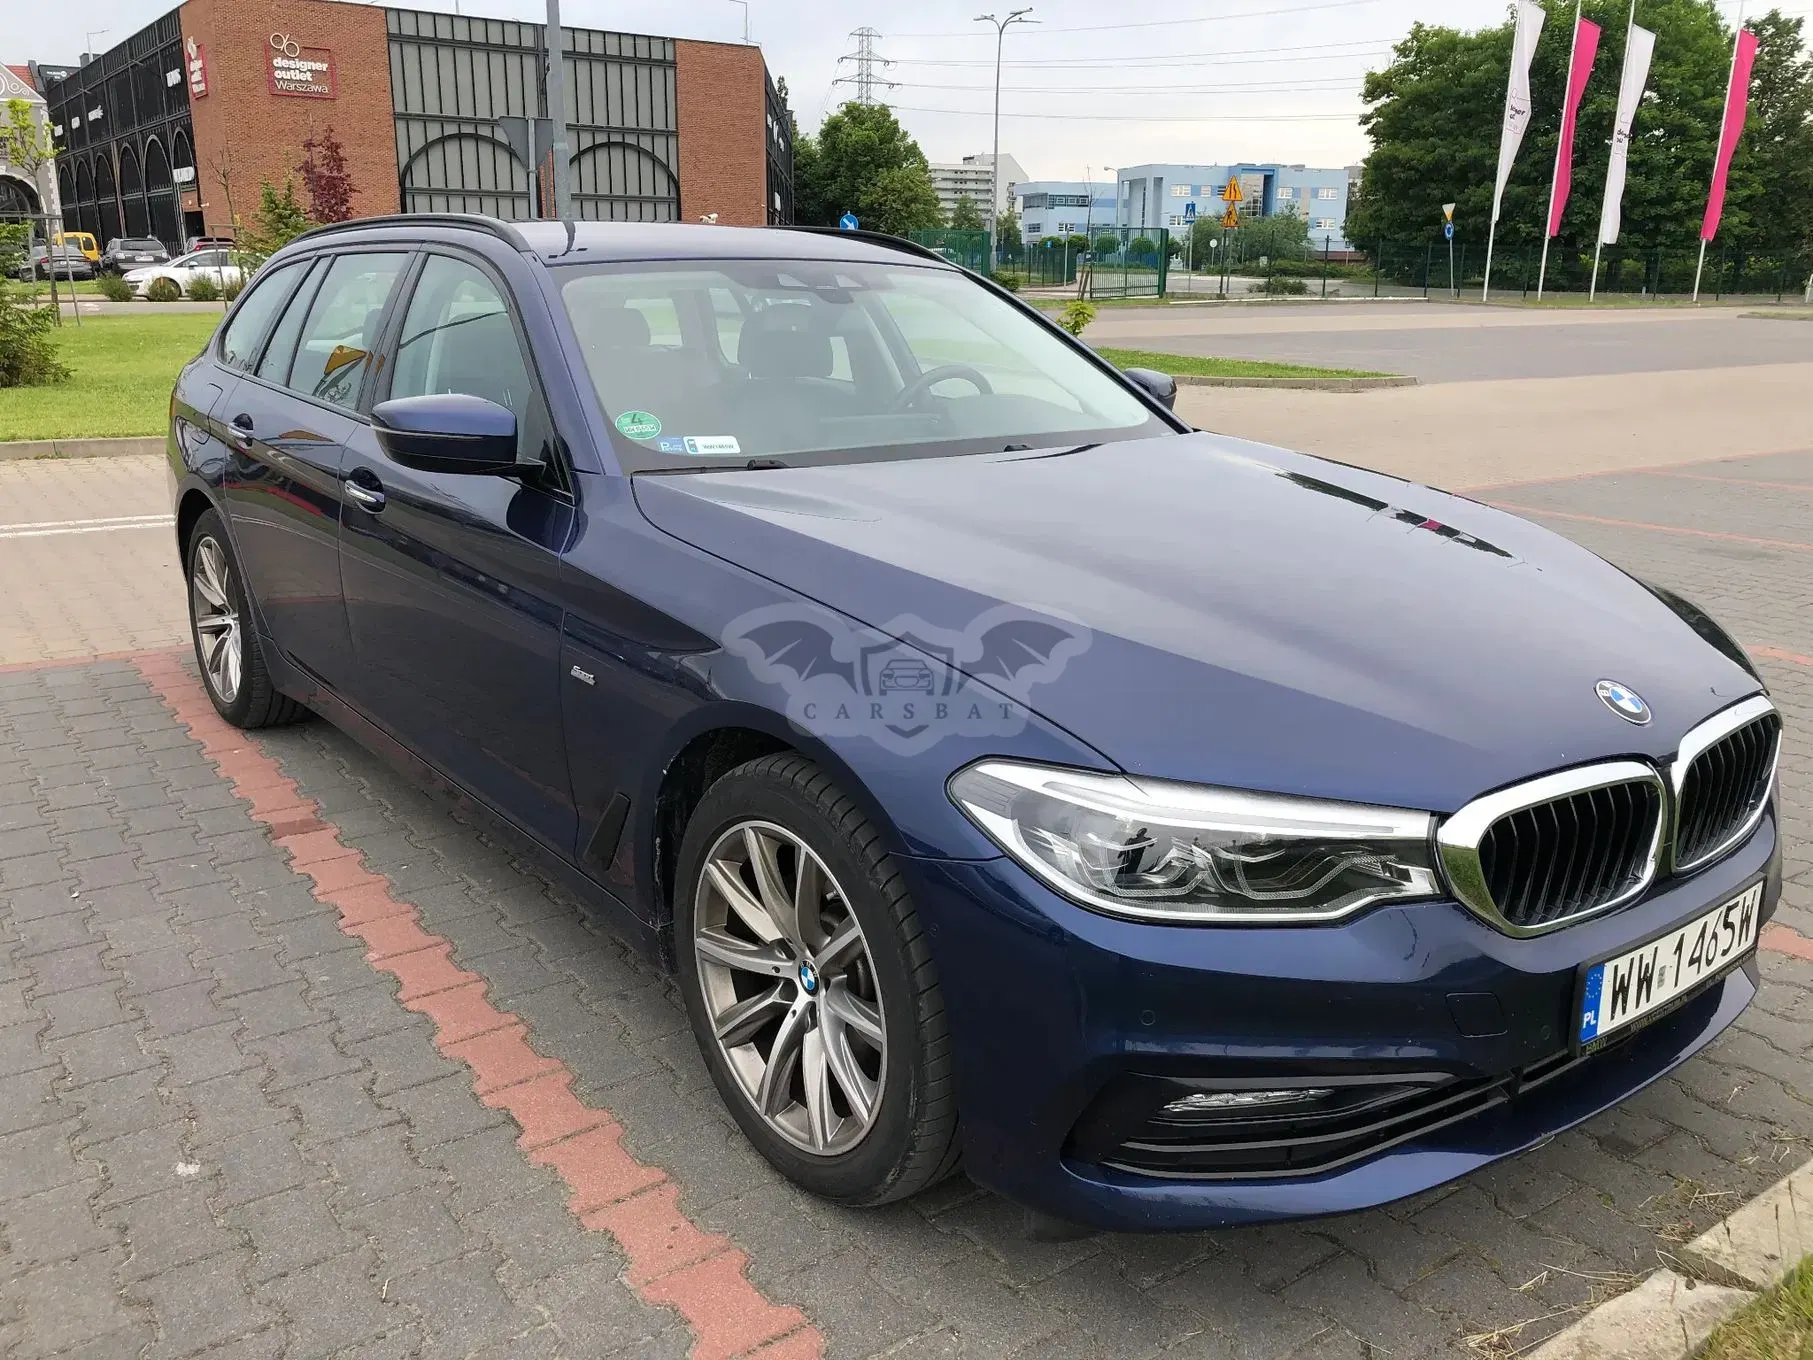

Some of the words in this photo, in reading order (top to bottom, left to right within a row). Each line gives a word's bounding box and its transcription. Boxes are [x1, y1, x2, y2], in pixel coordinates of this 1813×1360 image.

[273, 57, 328, 71] designer
[274, 69, 313, 81] outlet
[275, 80, 328, 93] Warszawa
[1610, 946, 1659, 1021] WW
[1673, 889, 1757, 988] 1465W
[1582, 1010, 1597, 1029] PL
